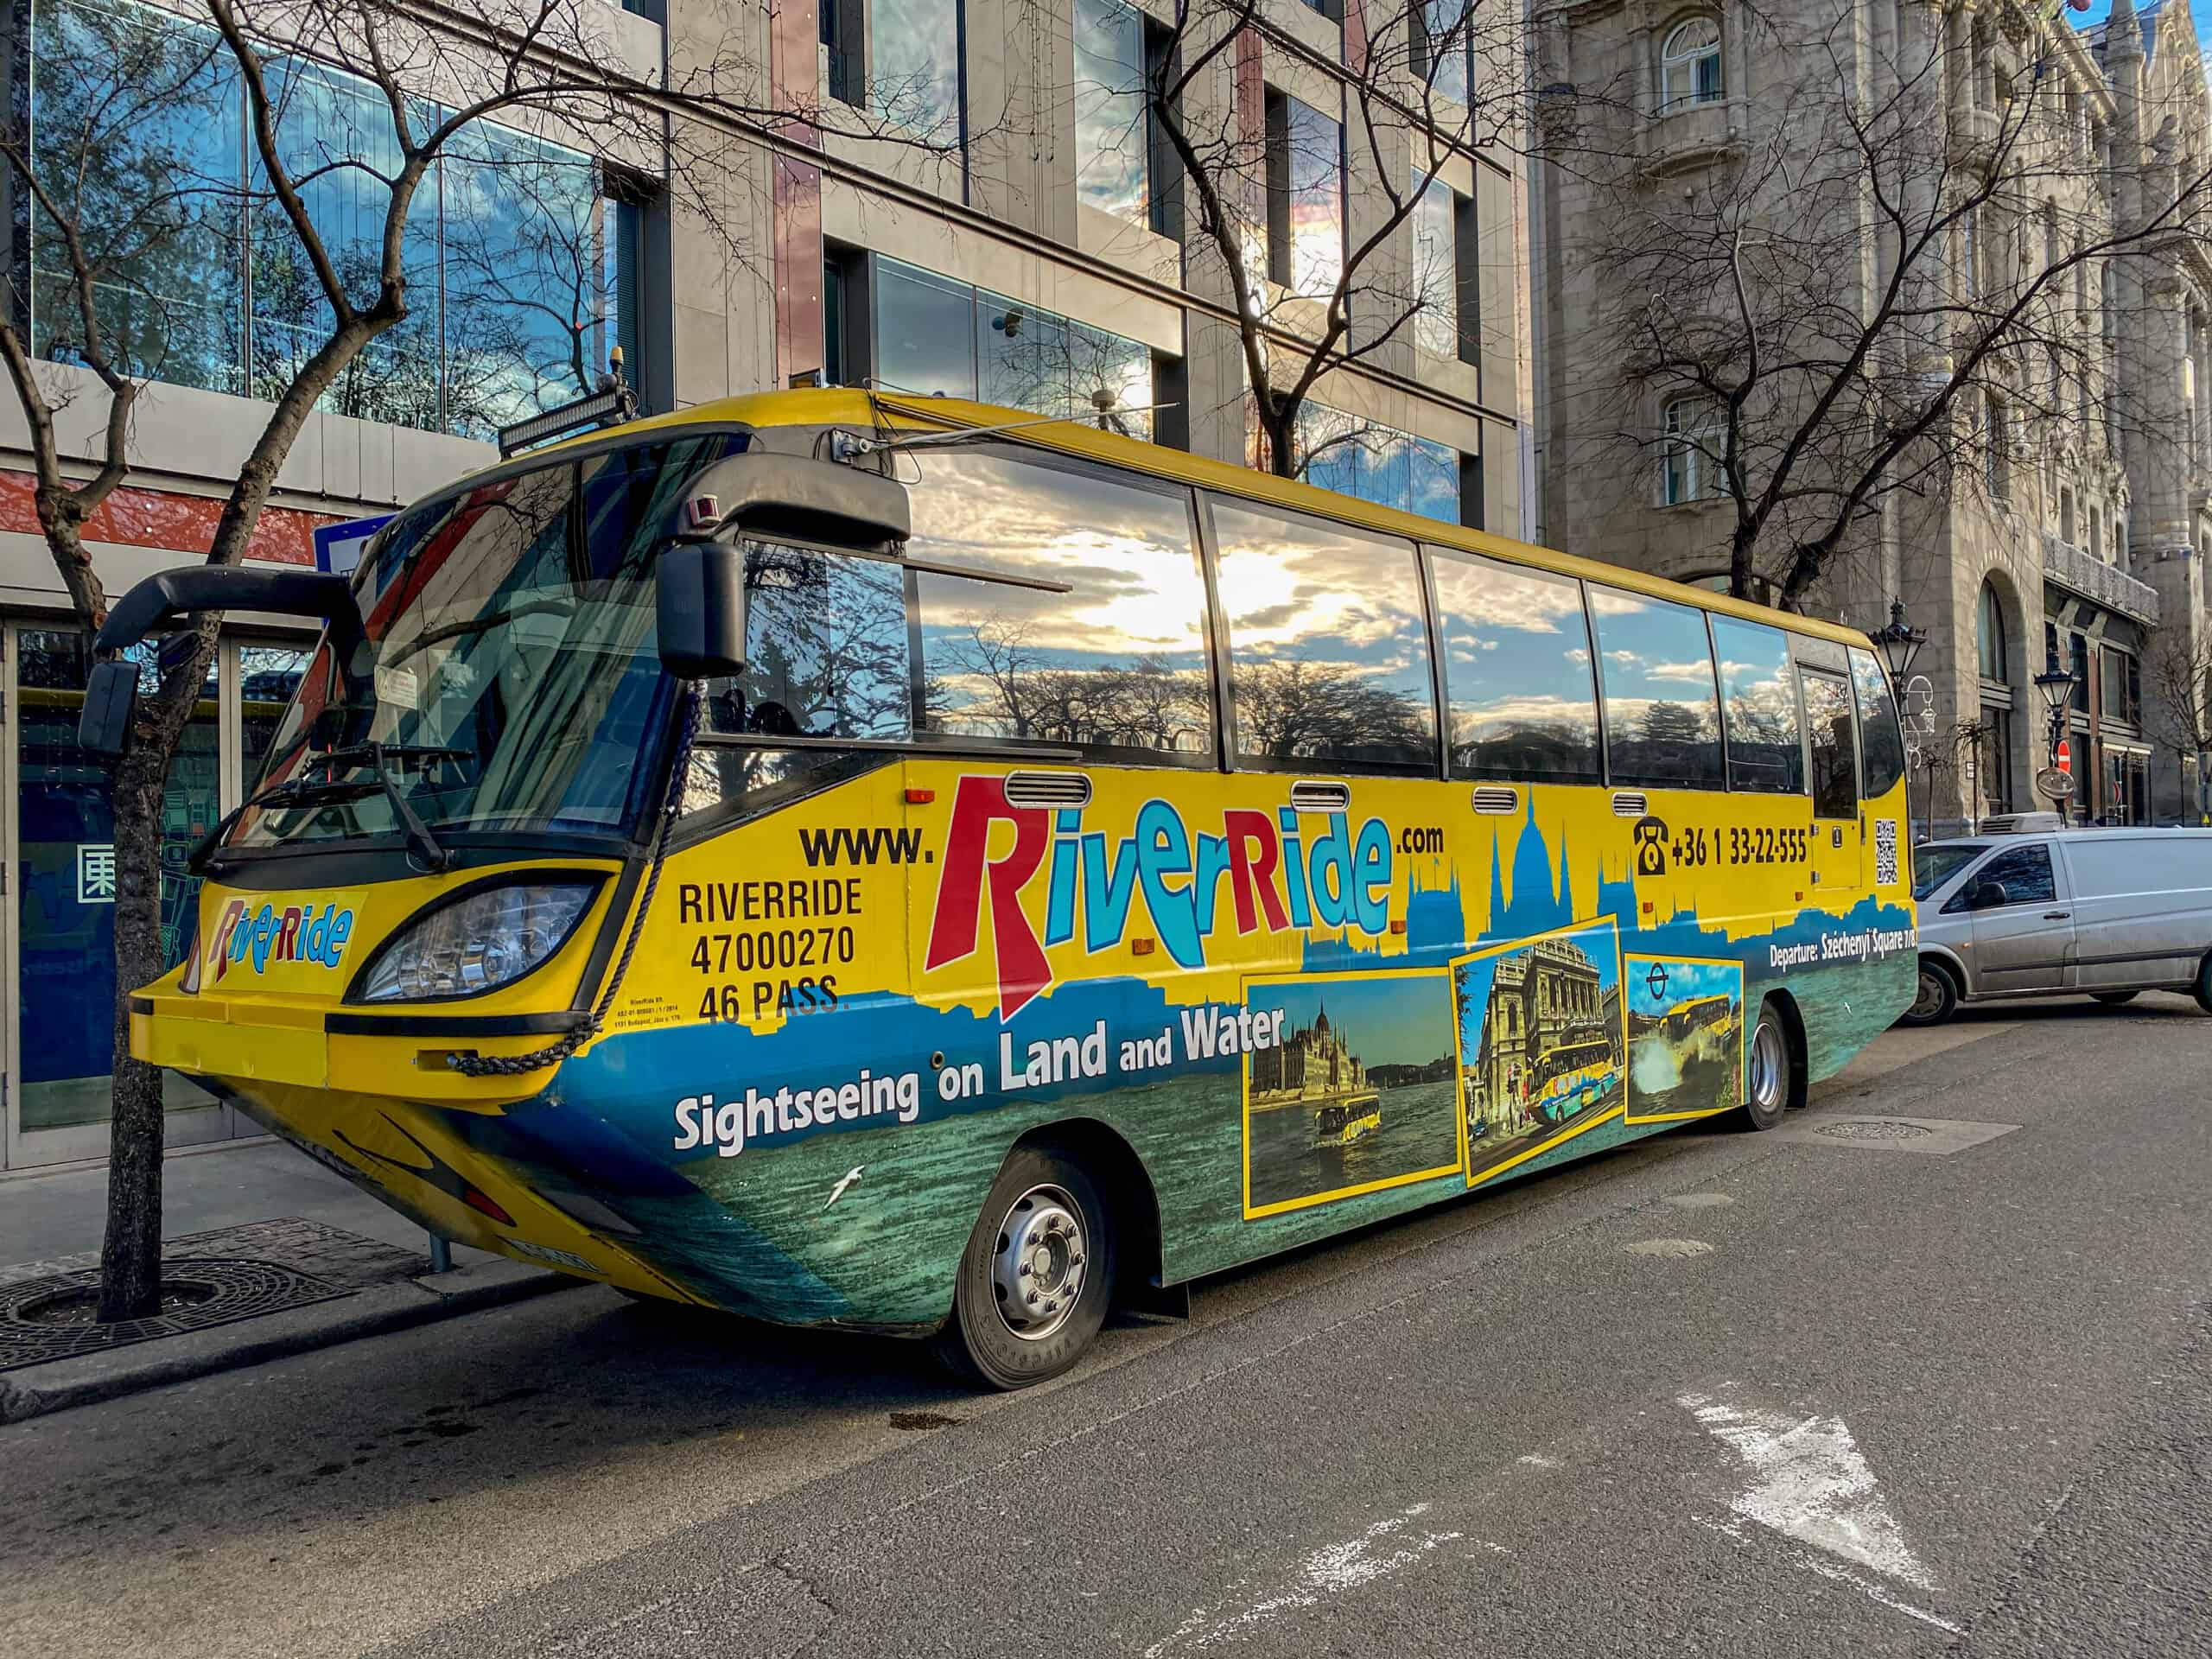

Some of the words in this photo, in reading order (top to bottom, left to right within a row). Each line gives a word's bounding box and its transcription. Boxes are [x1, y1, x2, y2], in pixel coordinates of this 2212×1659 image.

[1672, 827, 1707, 866] +36
[1713, 827, 1721, 865] 1
[1730, 827, 1807, 865] 33-22-555
[679, 878, 862, 924] RIVERRIDE
[798, 828, 934, 867] www.
[924, 774, 1391, 1024] RiverRide
[1395, 824, 1444, 854] .com
[208, 898, 353, 983] RiverRide
[690, 925, 855, 975] 47000270
[1770, 943, 1818, 972] Departure:
[1821, 927, 1871, 962] Széchenyi
[1872, 928, 1904, 959] Square
[697, 983, 740, 1025] 46
[753, 975, 850, 1020] PASS.
[674, 1069, 920, 1158] Sightseeing
[938, 1061, 984, 1098] on
[999, 1020, 1107, 1091] Land
[1120, 1027, 1172, 1072] and
[1179, 1006, 1286, 1062] Water
